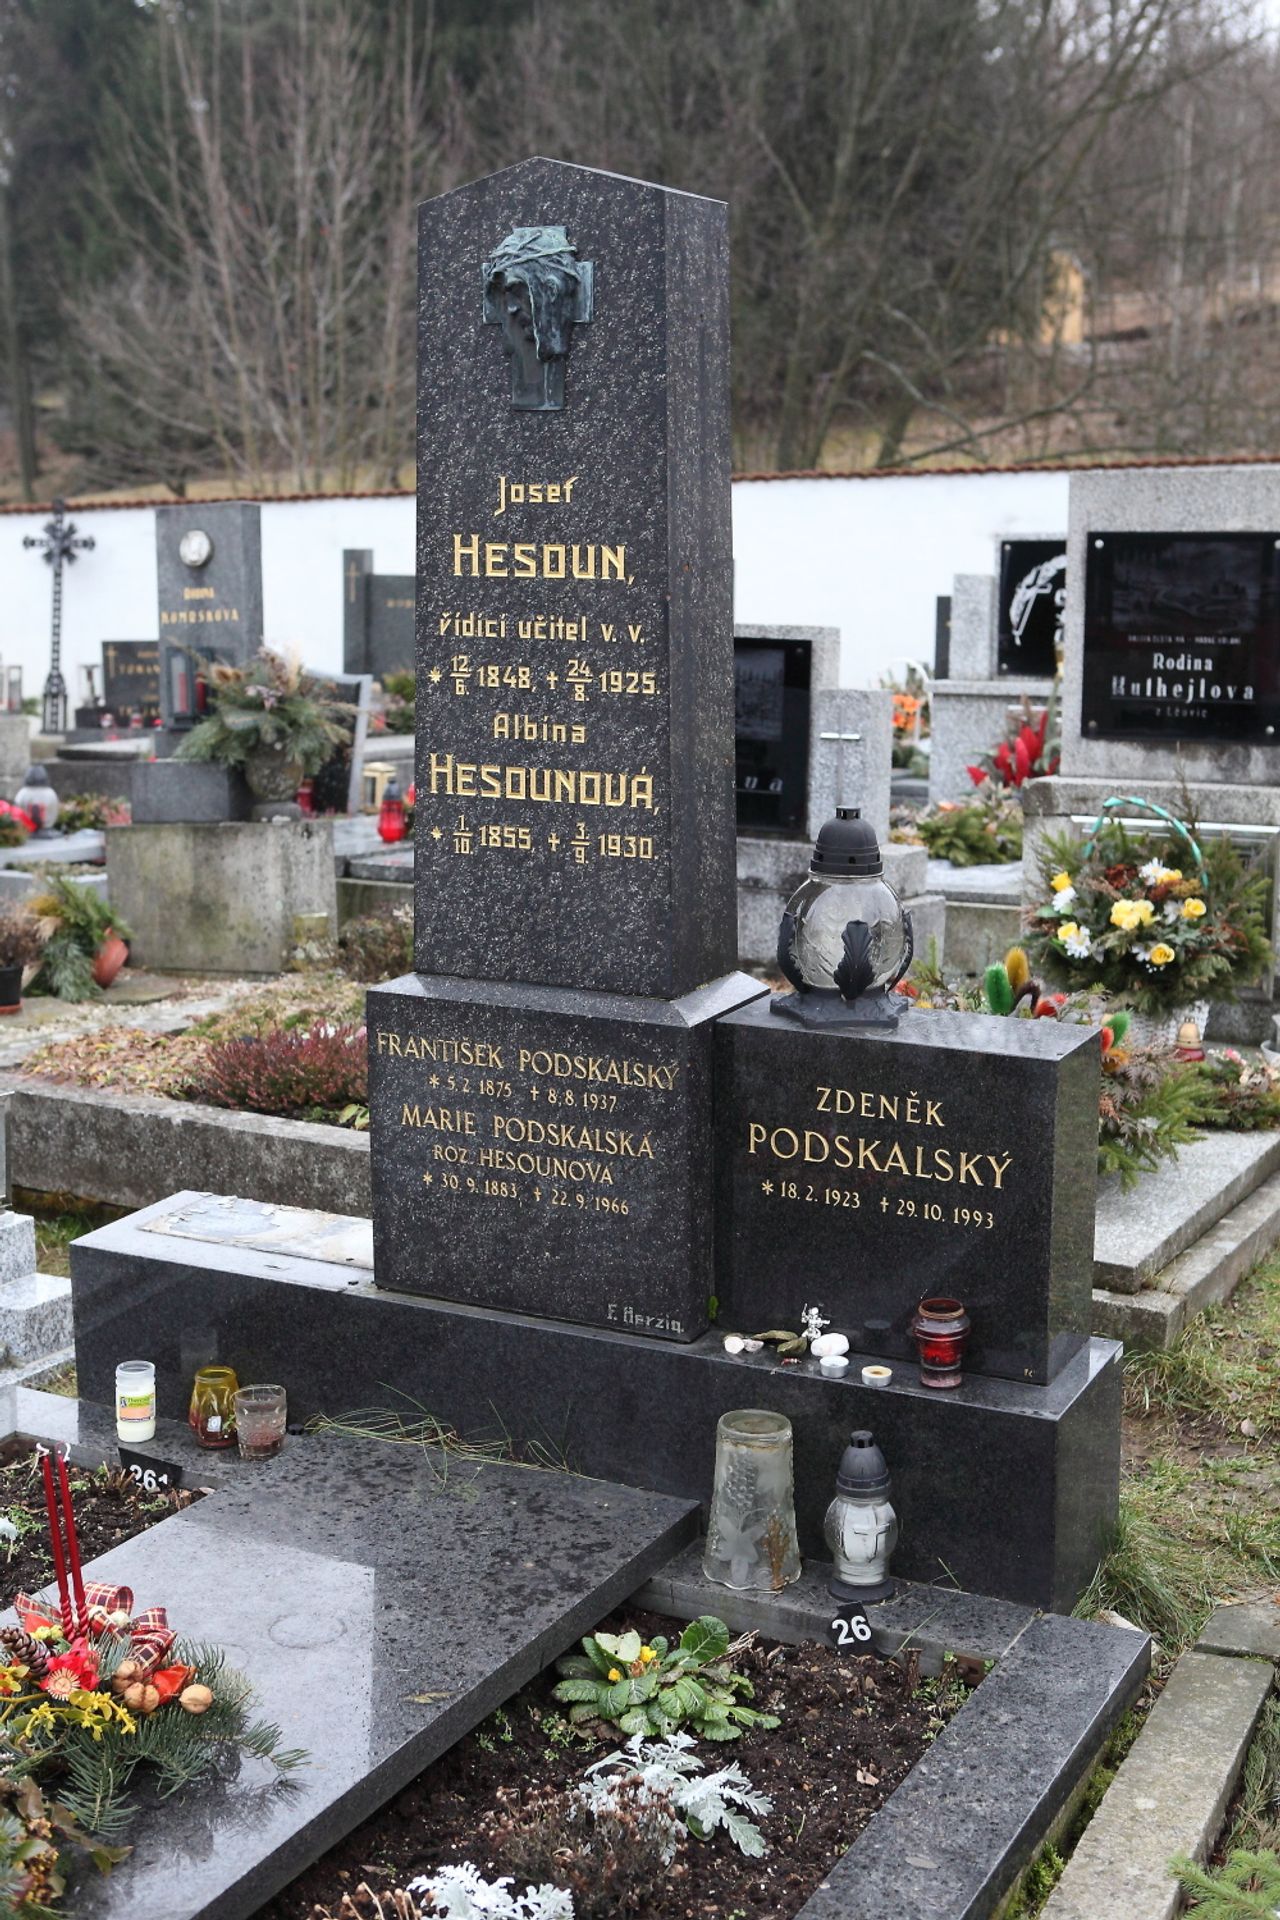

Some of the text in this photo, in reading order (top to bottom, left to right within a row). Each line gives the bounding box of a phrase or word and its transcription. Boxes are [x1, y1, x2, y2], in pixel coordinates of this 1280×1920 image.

[493, 476, 579, 516] Josef
[453, 533, 636, 586] HESOUN,
[518, 614, 587, 641] učitel
[1153, 652, 1213, 671] Rodina
[377, 1032, 680, 1091] FRANTIŠEK PODSKALSKÝ
[816, 1086, 945, 1127] ZDENĚK
[401, 1103, 655, 1160] MARIE PODSKALSKÁ
[748, 1122, 1013, 1189] PODSKALSKÝ
[825, 1188, 861, 1209] 1923
[953, 1207, 995, 1229] 1993
[831, 1615, 871, 1645] 26
